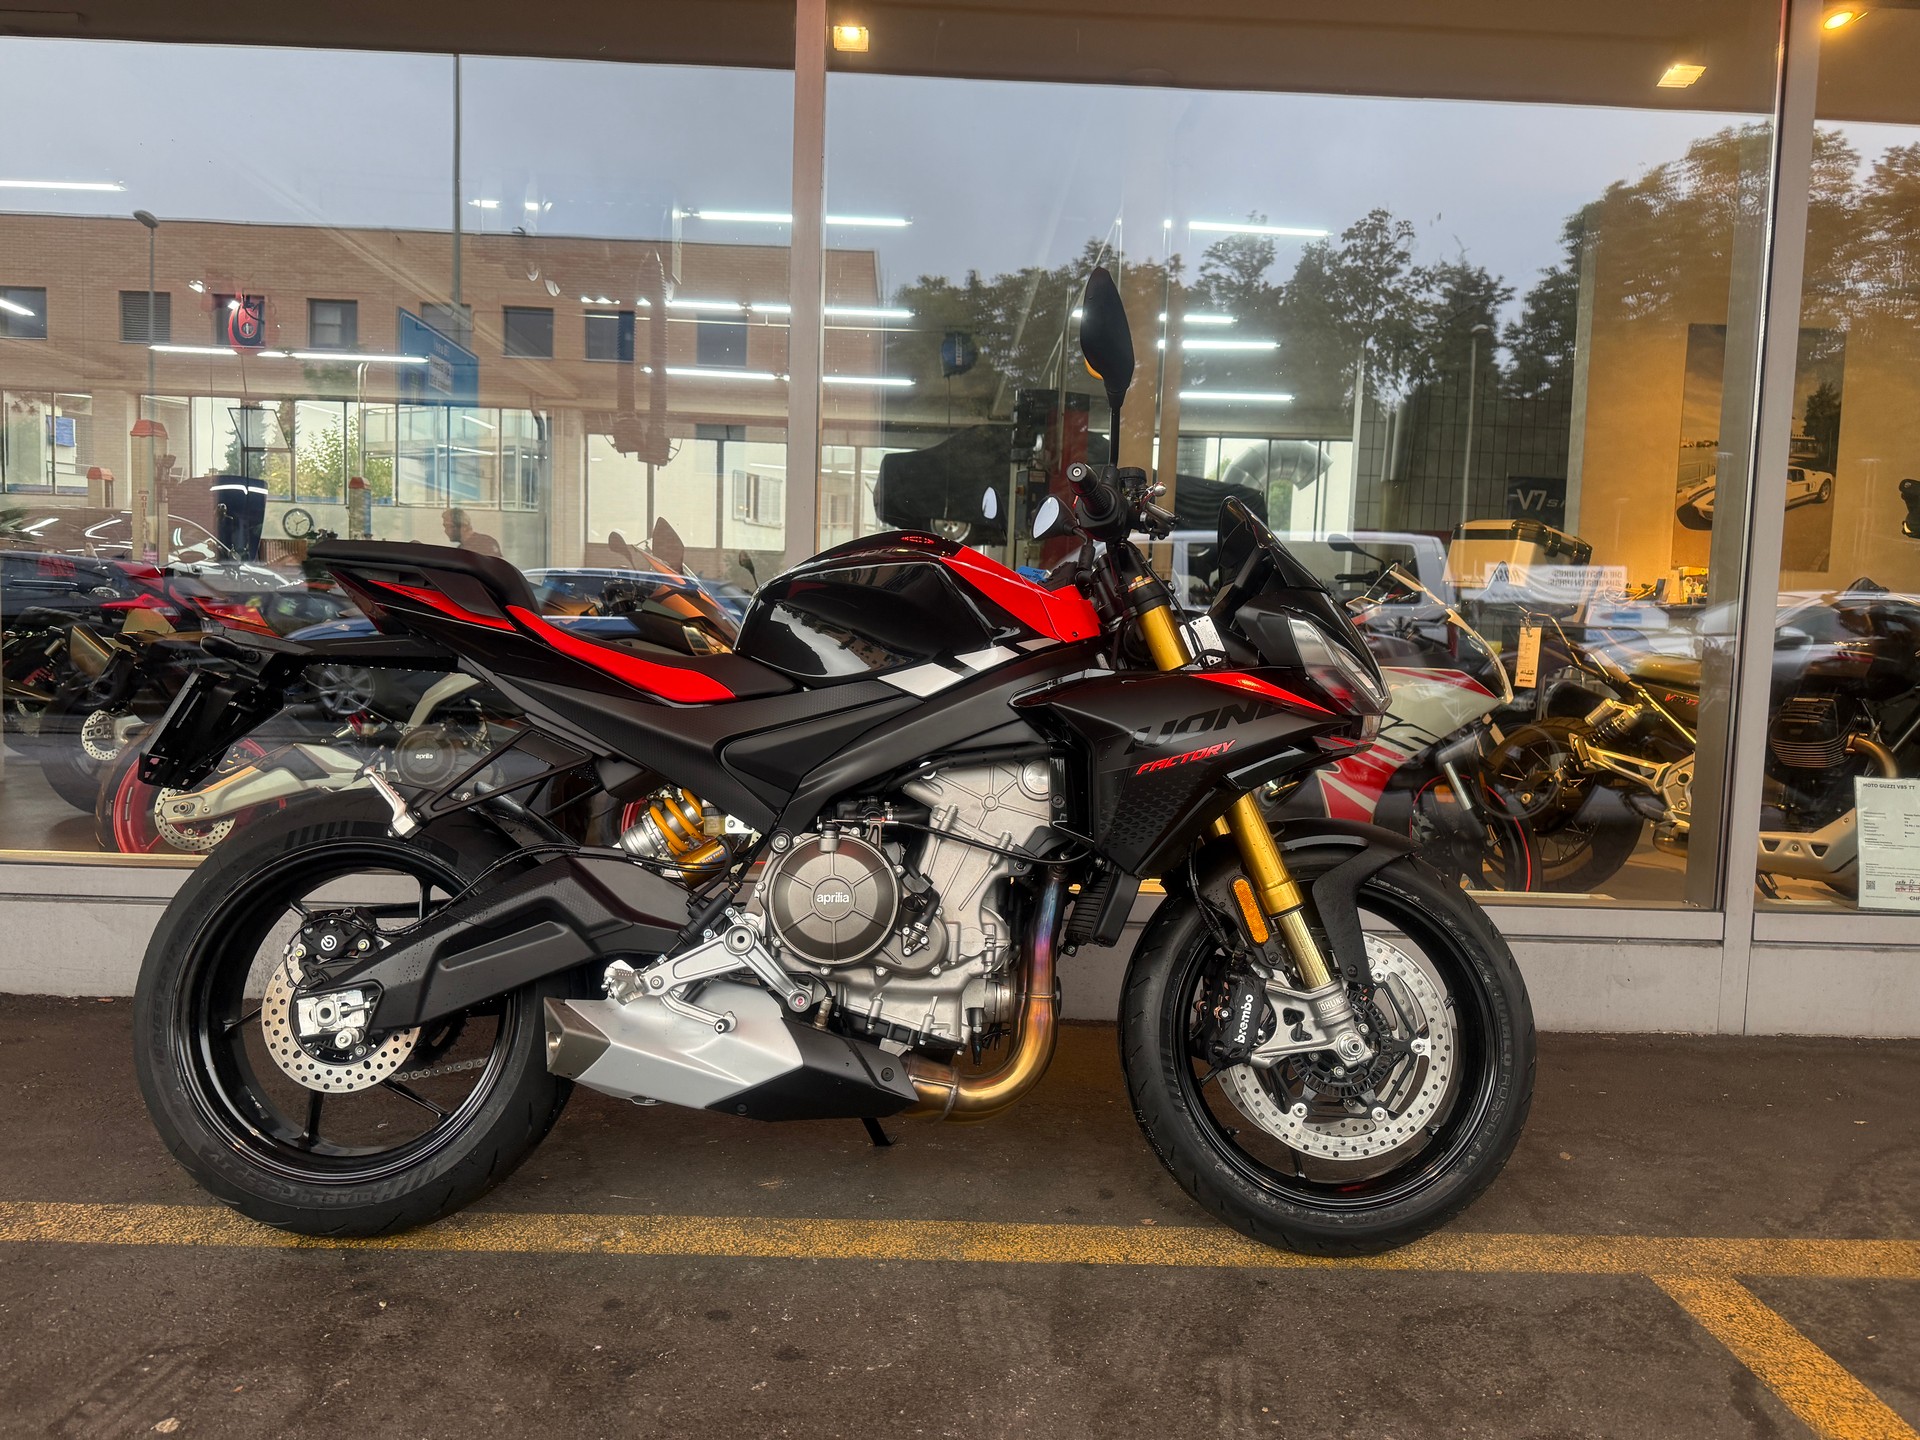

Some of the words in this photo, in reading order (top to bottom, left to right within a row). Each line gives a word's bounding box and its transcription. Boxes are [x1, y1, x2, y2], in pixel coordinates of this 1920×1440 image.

[1516, 488, 1547, 511] V7
[415, 752, 434, 760] aprilia
[1135, 739, 1236, 776] FACTORY
[816, 891, 850, 906] aprilia
[1234, 994, 1254, 1044] brembo
